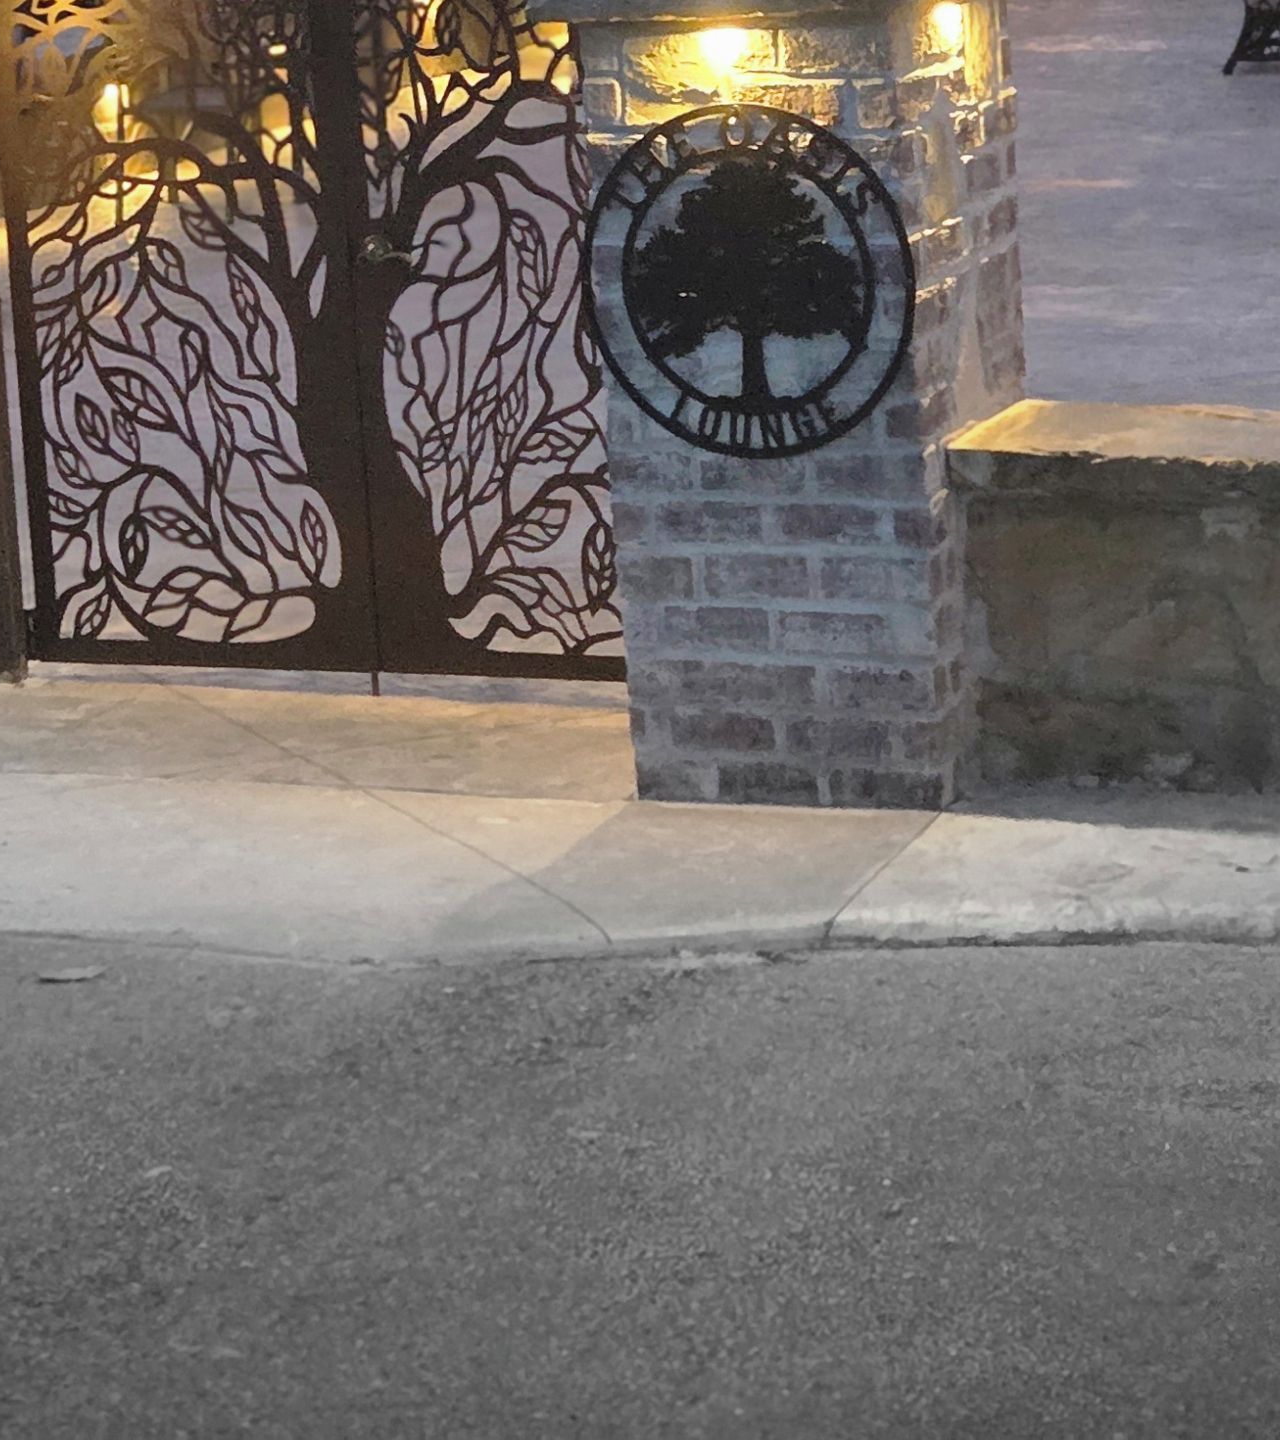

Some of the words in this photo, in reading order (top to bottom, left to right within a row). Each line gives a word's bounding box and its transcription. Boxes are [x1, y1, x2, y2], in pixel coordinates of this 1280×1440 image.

[601, 119, 696, 210] THE
[722, 110, 884, 218] OASIS
[670, 391, 846, 448] LOUNGE
